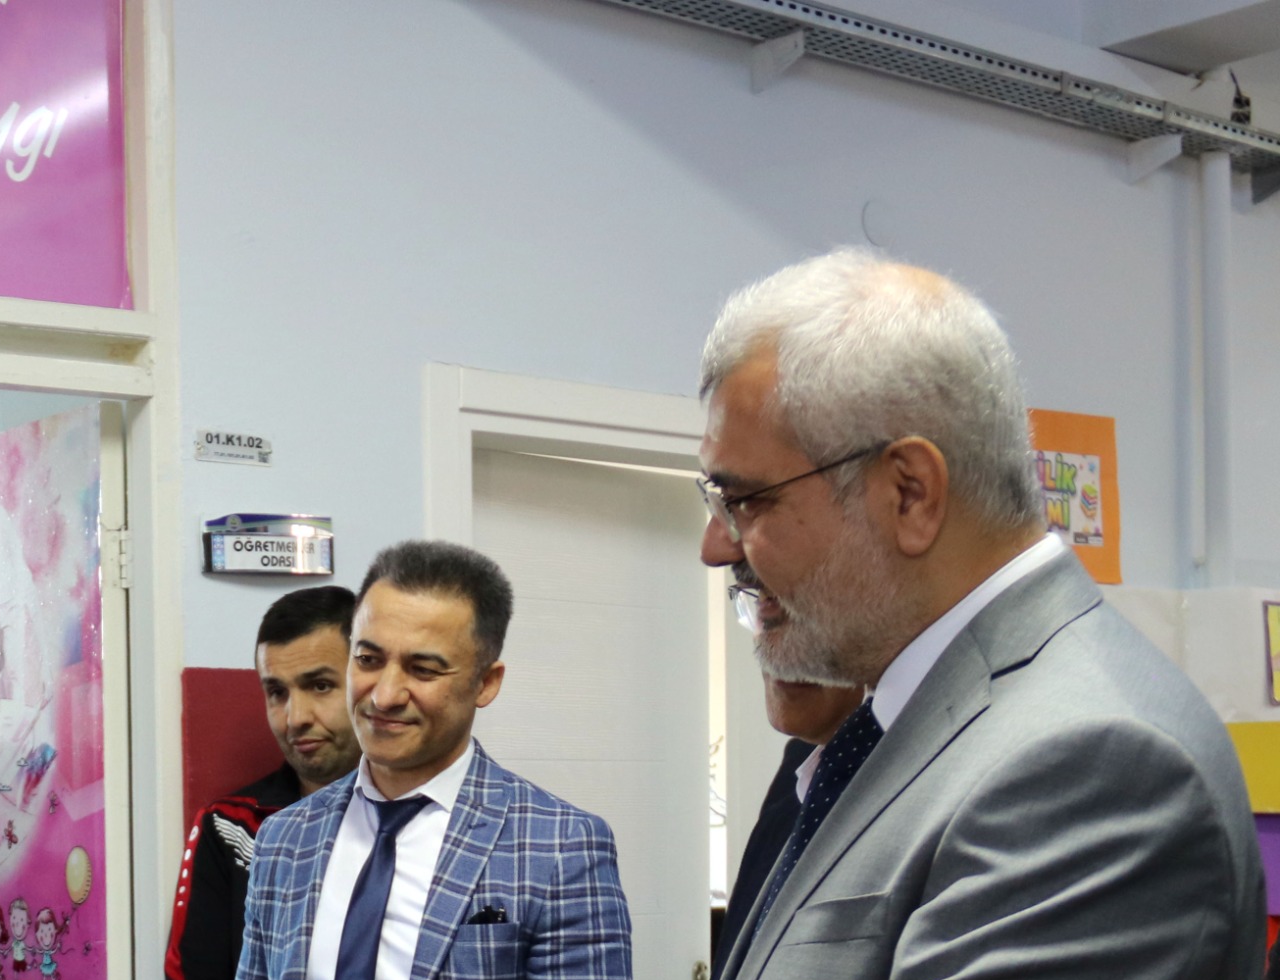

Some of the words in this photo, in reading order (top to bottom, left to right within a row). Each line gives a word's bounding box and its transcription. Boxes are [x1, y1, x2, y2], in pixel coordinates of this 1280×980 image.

[205, 432, 263, 449] 01.K1.02
[233, 537, 315, 554] ÖĞRETMENER
[260, 555, 295, 567] ODASI
